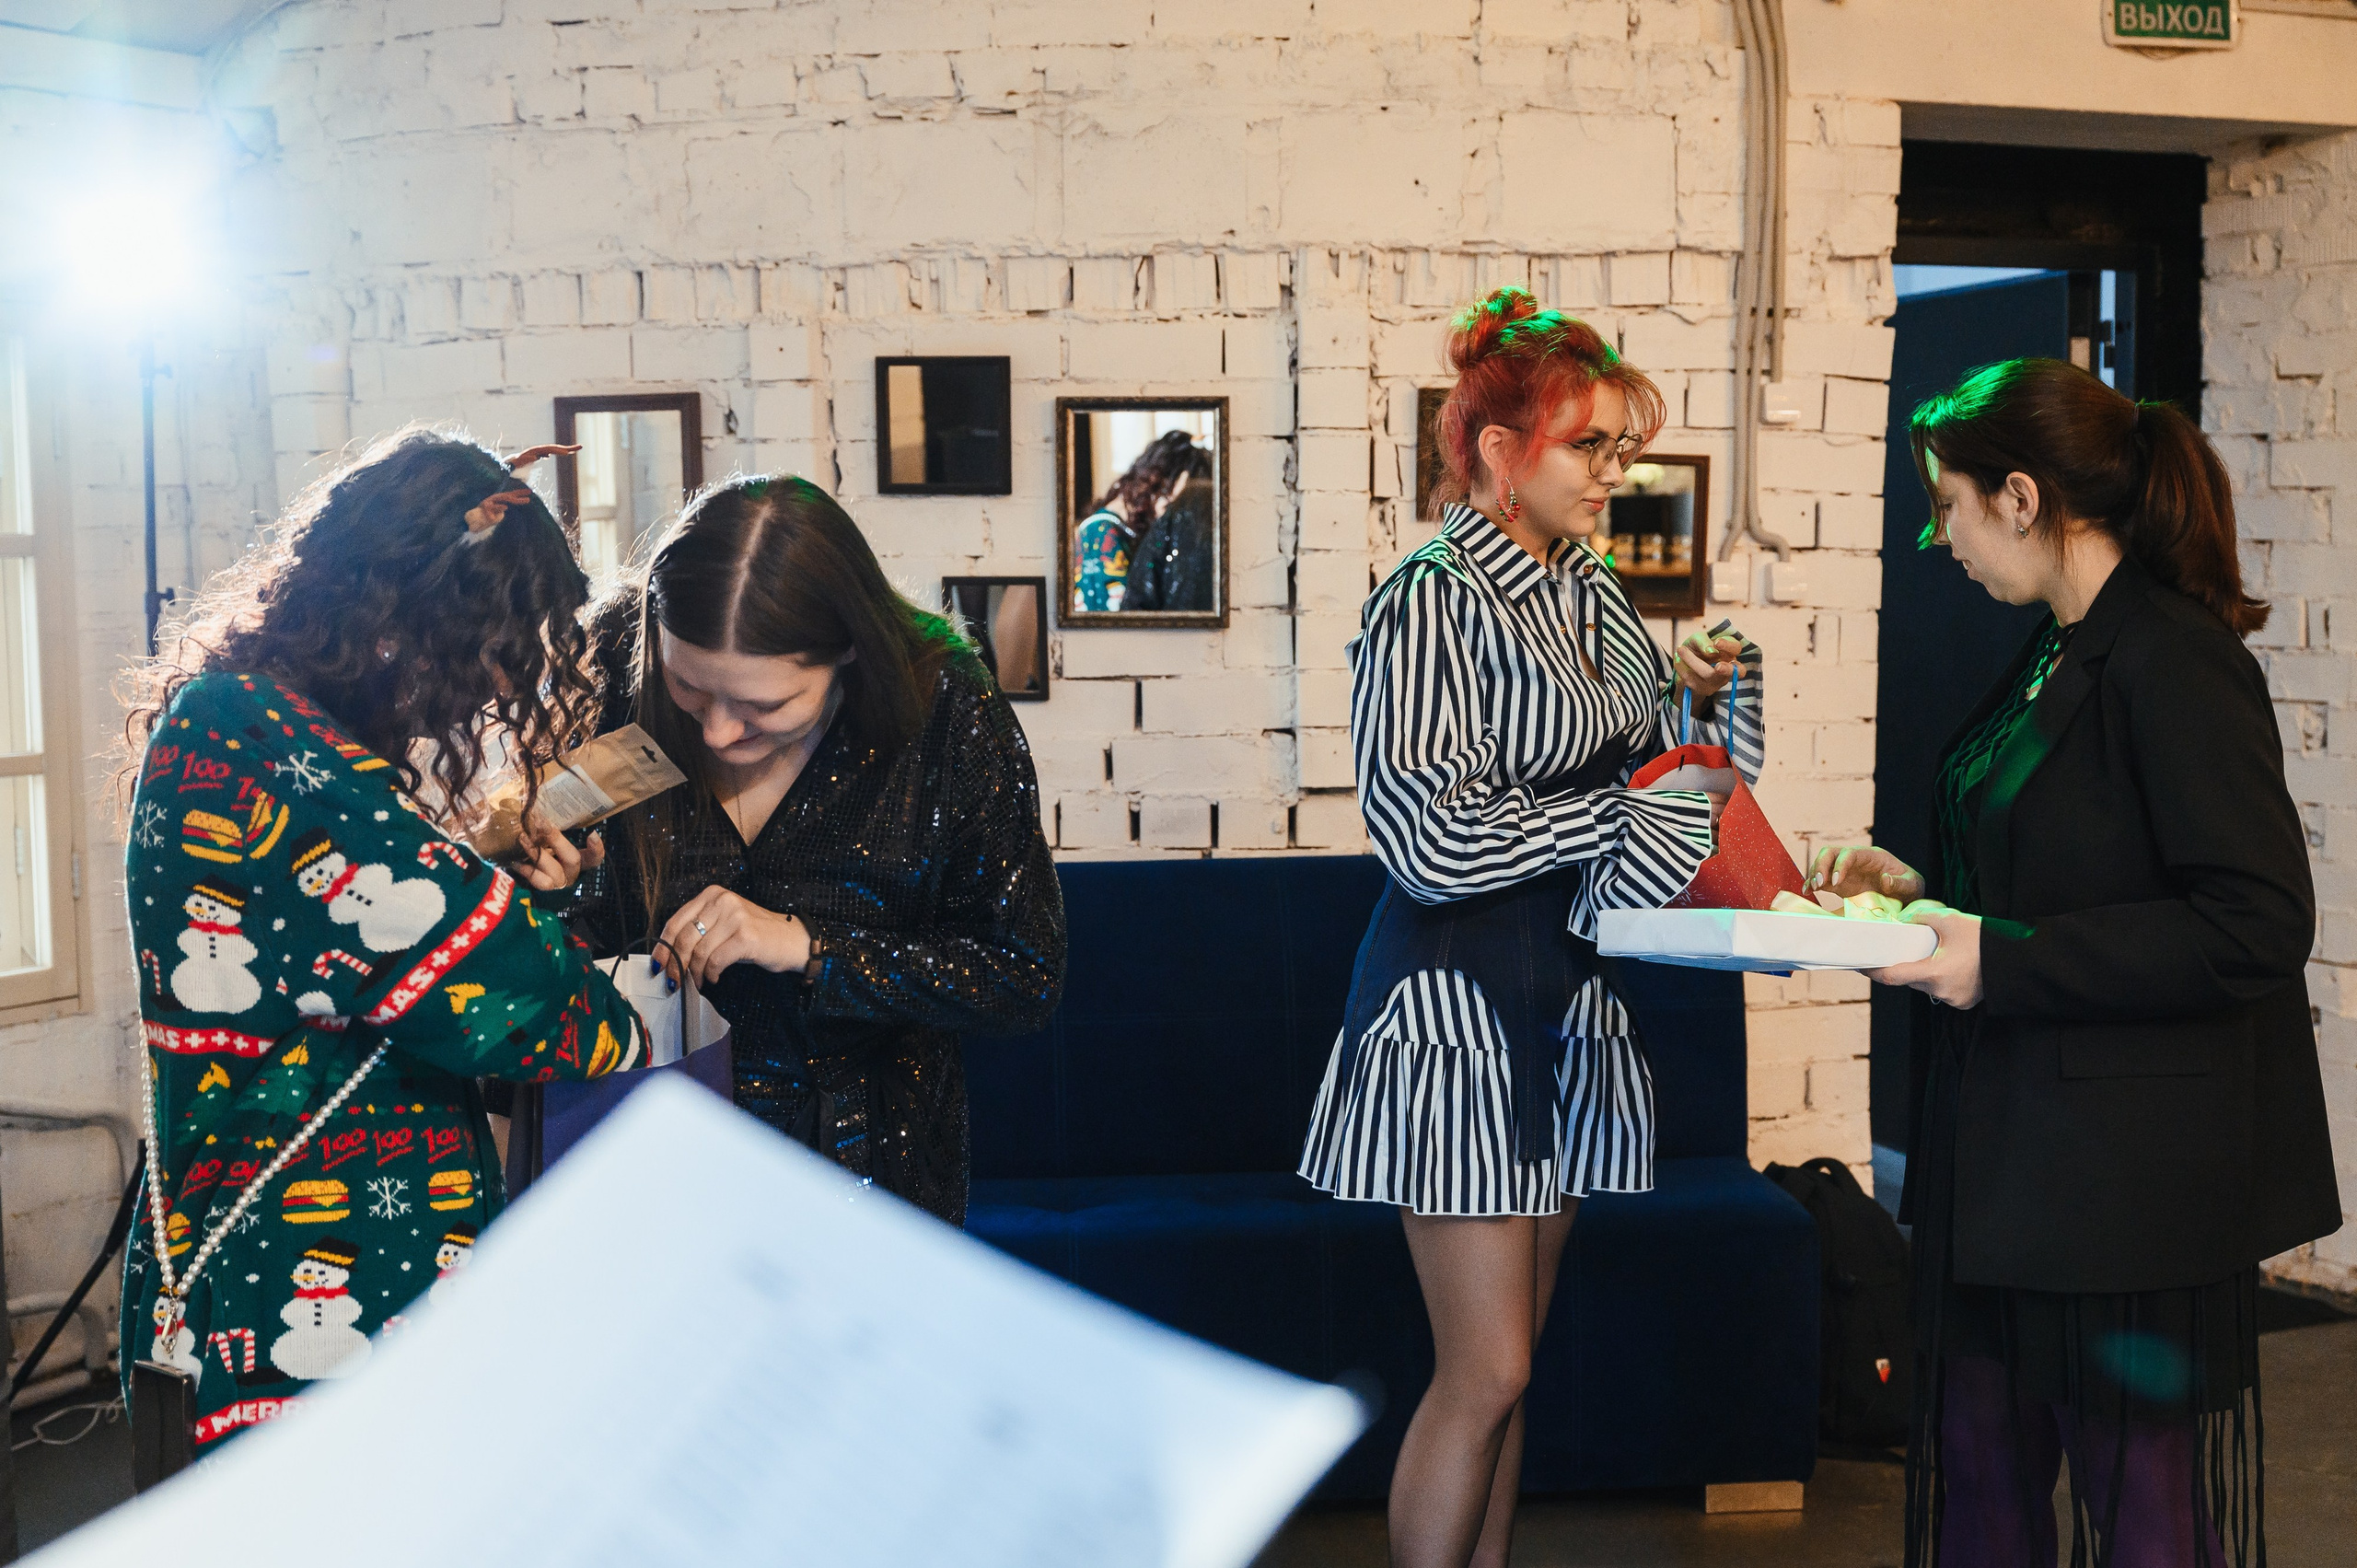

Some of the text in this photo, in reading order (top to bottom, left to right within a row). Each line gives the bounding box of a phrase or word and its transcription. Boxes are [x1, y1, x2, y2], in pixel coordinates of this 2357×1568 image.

[2119, 2, 2224, 36] ВЫХОД
[183, 750, 232, 780] 100
[319, 1128, 366, 1160] 100
[373, 1127, 412, 1156] 100
[421, 1126, 459, 1154] 100
